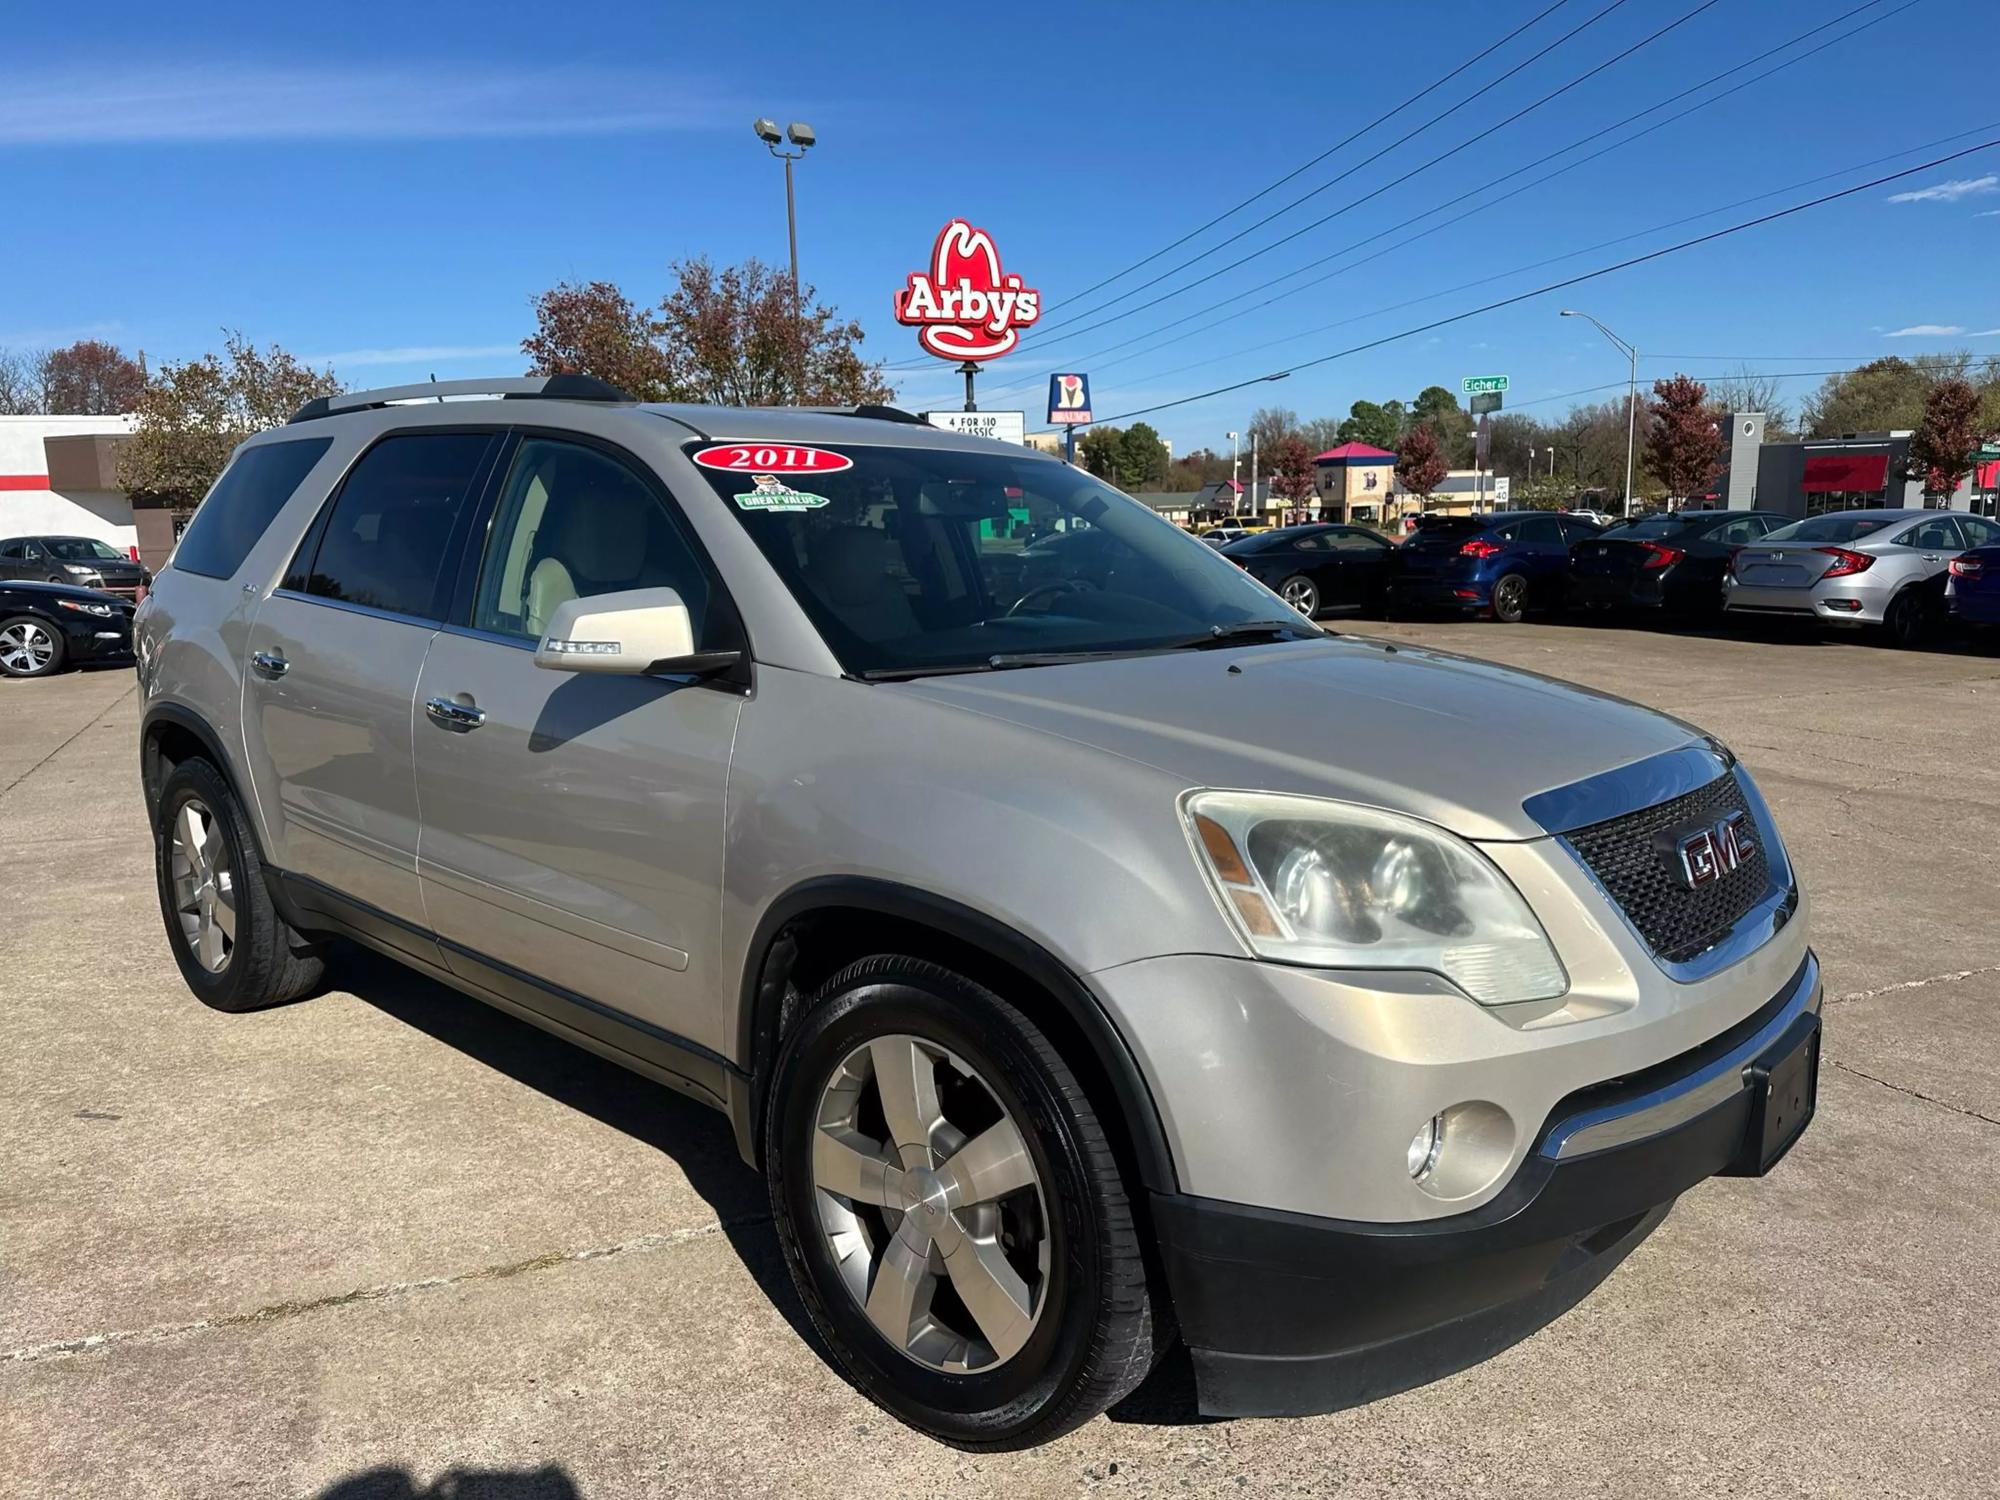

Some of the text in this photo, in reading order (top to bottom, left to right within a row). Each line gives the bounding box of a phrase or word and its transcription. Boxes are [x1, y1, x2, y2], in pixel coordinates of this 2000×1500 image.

[905, 277, 1038, 332] Arby's
[1465, 379, 1496, 391] Eicher
[949, 418, 955, 427] 4
[961, 417, 979, 427] FOR
[729, 449, 818, 467] 2011
[744, 495, 817, 505] GREAT VALUE
[1676, 810, 1757, 889] GMC
